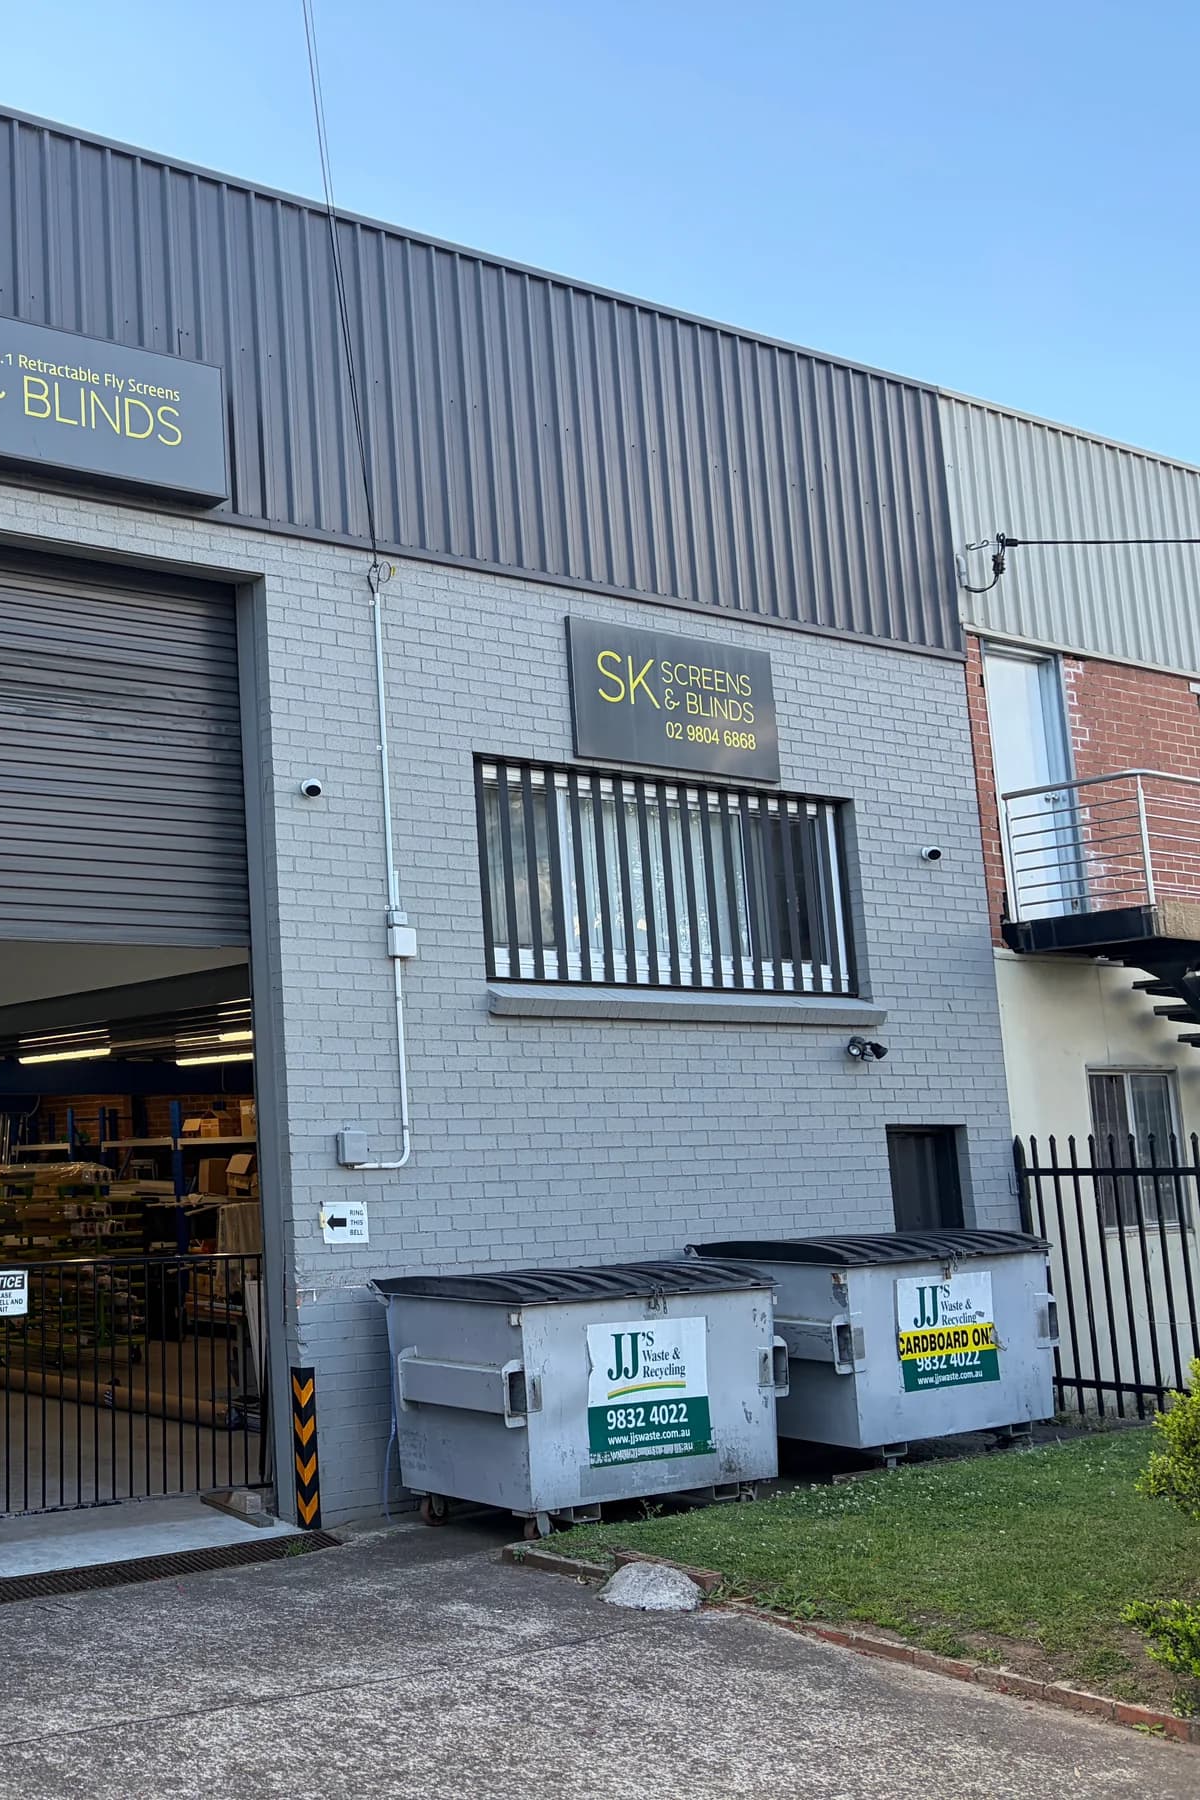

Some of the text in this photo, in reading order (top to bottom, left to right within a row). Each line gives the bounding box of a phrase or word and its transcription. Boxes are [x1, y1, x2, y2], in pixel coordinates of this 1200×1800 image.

[18, 354, 100, 385] Retractable
[104, 373, 125, 393] Fly
[128, 379, 181, 402] Screens
[23, 375, 182, 446] BLINDS
[596, 650, 661, 709] SK
[660, 661, 752, 697] SCREENS
[664, 688, 755, 724] & BLINDS
[665, 721, 757, 751] 02 9804 6868
[940, 1298, 973, 1312] Waste &
[941, 1312, 977, 1327] Recycling
[642, 1347, 681, 1362] Waste &
[899, 1330, 969, 1356] CARDBOARD
[642, 1363, 686, 1380] Recycling
[915, 1351, 981, 1372] 9832 4022
[917, 1369, 983, 1385] www.jjswaste.com.au
[606, 1403, 689, 1431] 9832 4022
[607, 1428, 691, 1446] www.jjswaste.com.au
